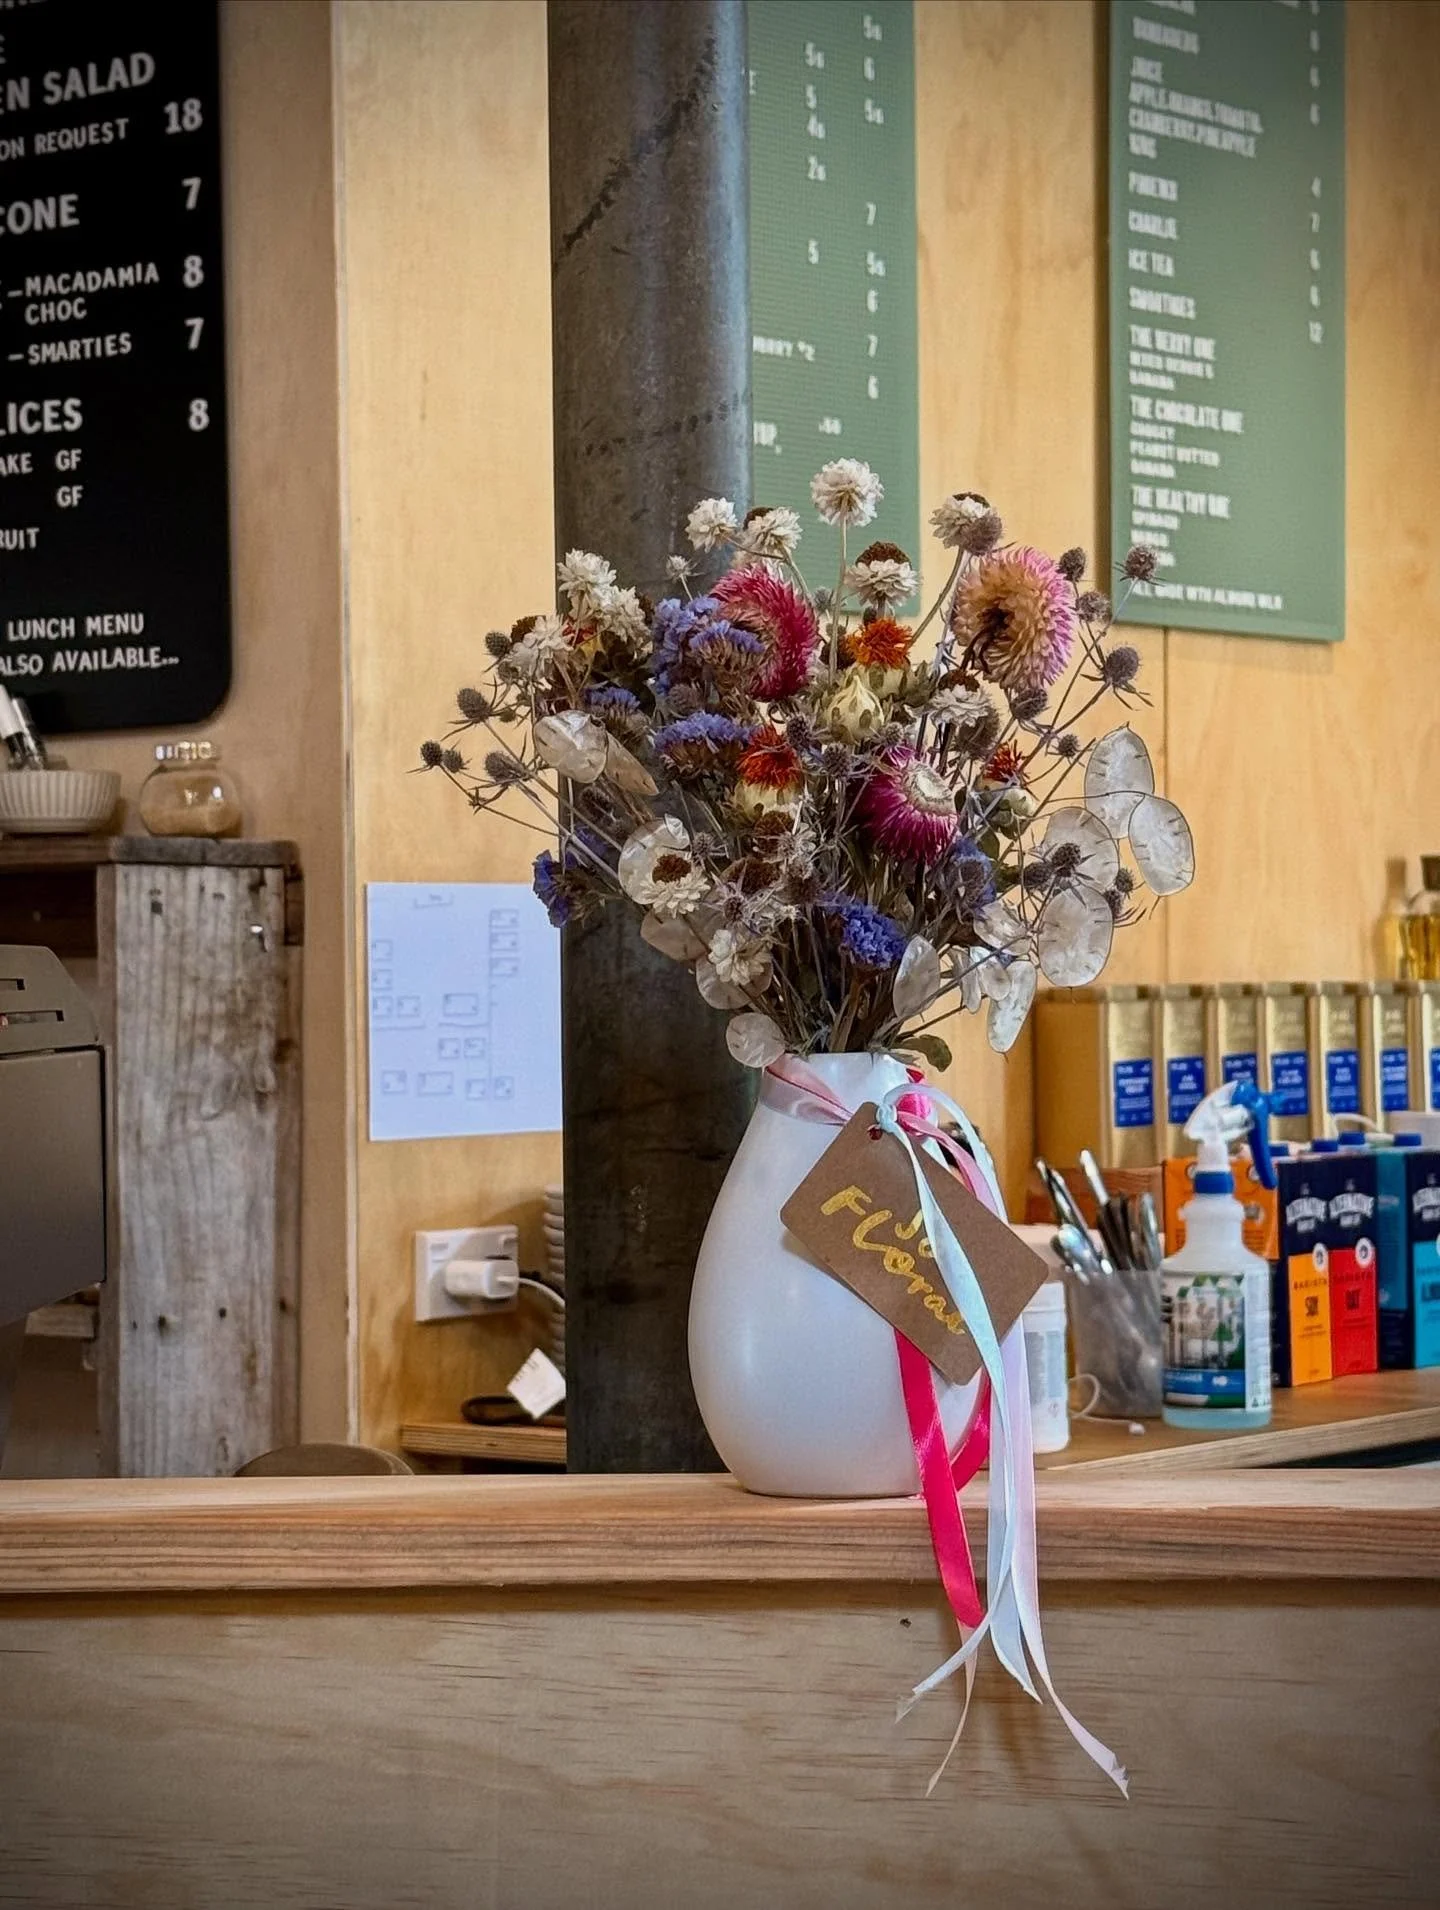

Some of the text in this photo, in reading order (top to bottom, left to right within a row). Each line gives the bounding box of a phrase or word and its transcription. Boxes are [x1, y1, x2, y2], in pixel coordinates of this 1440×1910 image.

[43, 52, 155, 106] SALAD
[34, 118, 129, 156] REQUEST
[164, 98, 203, 134] 18
[0, 177, 202, 235] ONE 7
[183, 255, 205, 288] 8
[24, 297, 88, 326] CHOC
[184, 317, 205, 350] 7
[187, 398, 210, 432] 8
[55, 448, 82, 472] GF
[56, 484, 84, 508] GF
[7, 611, 146, 643] LUNCH MENU
[0, 645, 181, 677] ALSO AVAILABLE...
